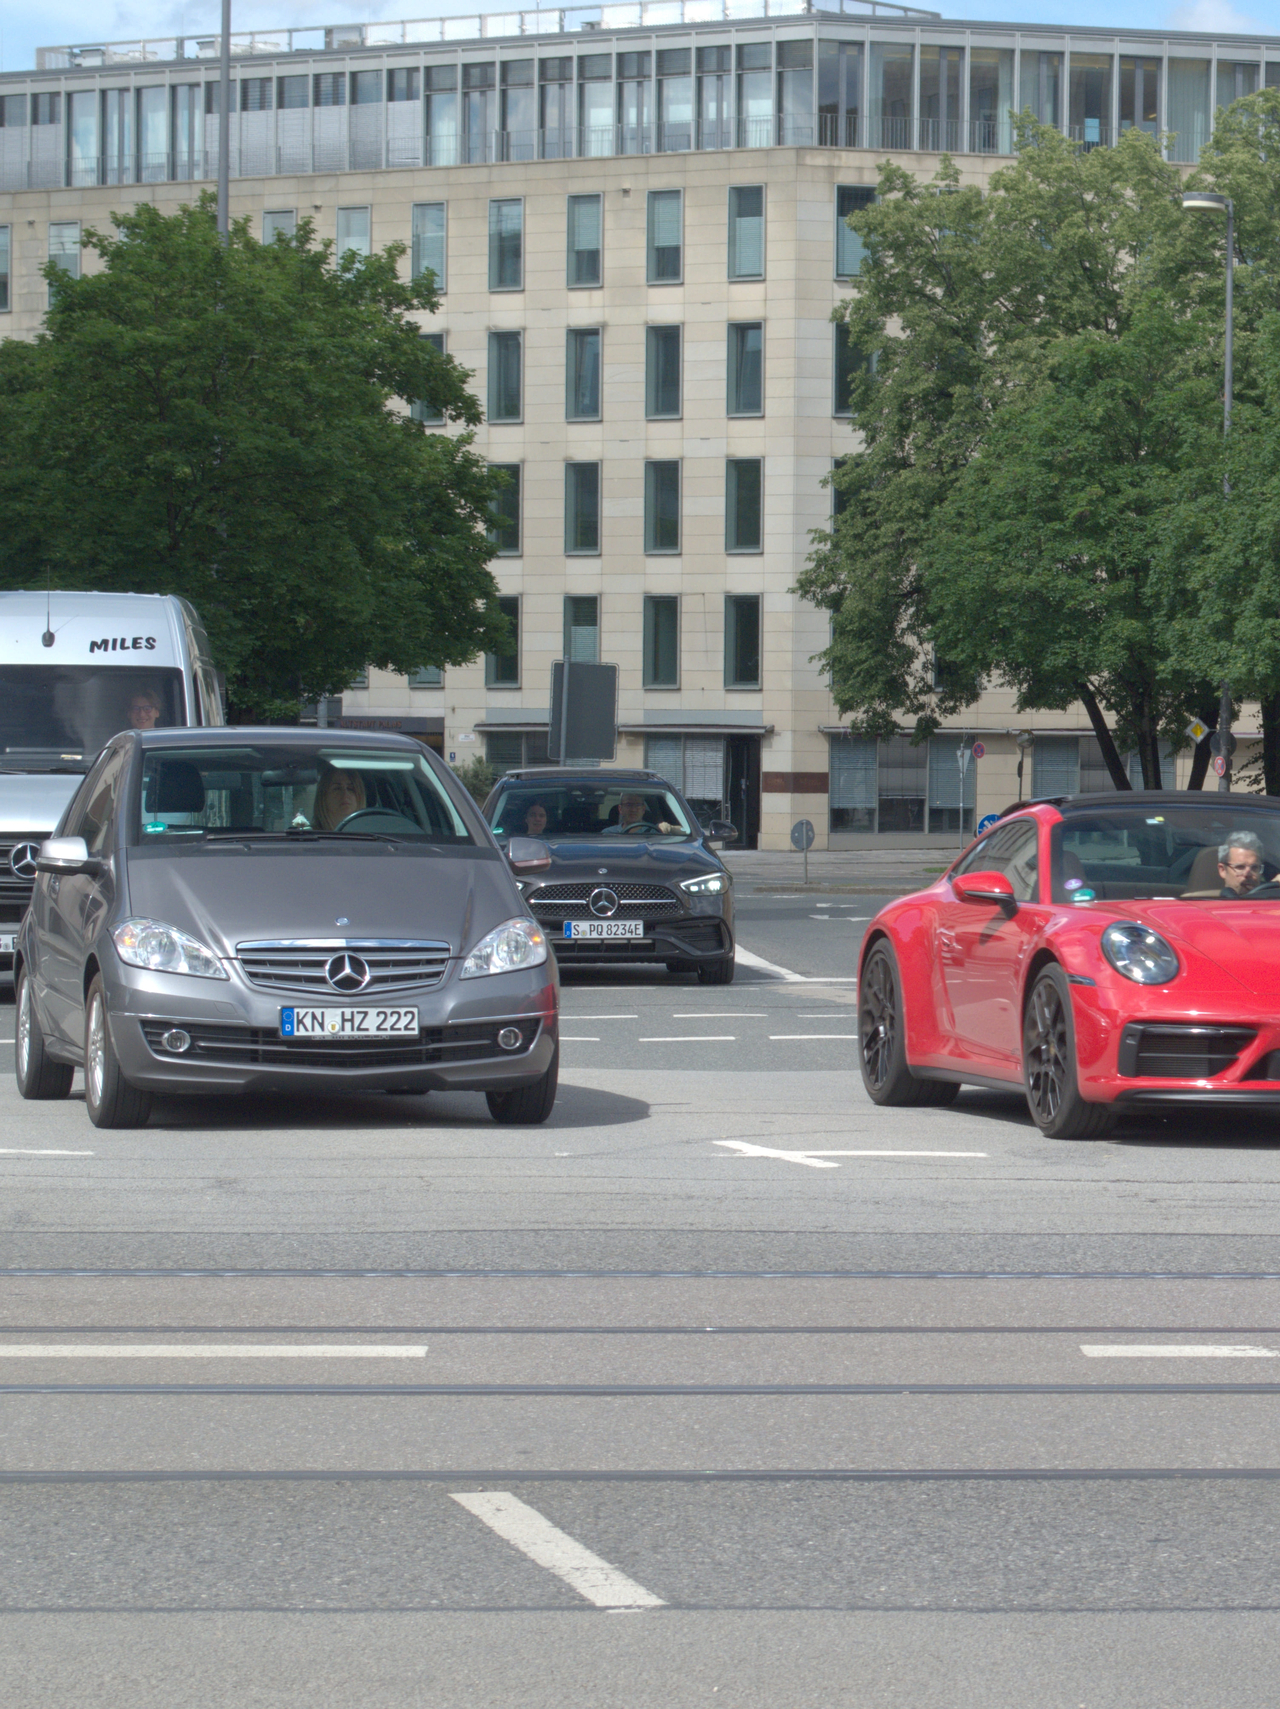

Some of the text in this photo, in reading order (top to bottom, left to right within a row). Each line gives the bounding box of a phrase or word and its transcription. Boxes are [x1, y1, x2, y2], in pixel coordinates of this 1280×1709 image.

[89, 636, 157, 653] MILES
[573, 923, 641, 936] S PQ 8234E
[296, 1010, 416, 1032] KN HZ 222
